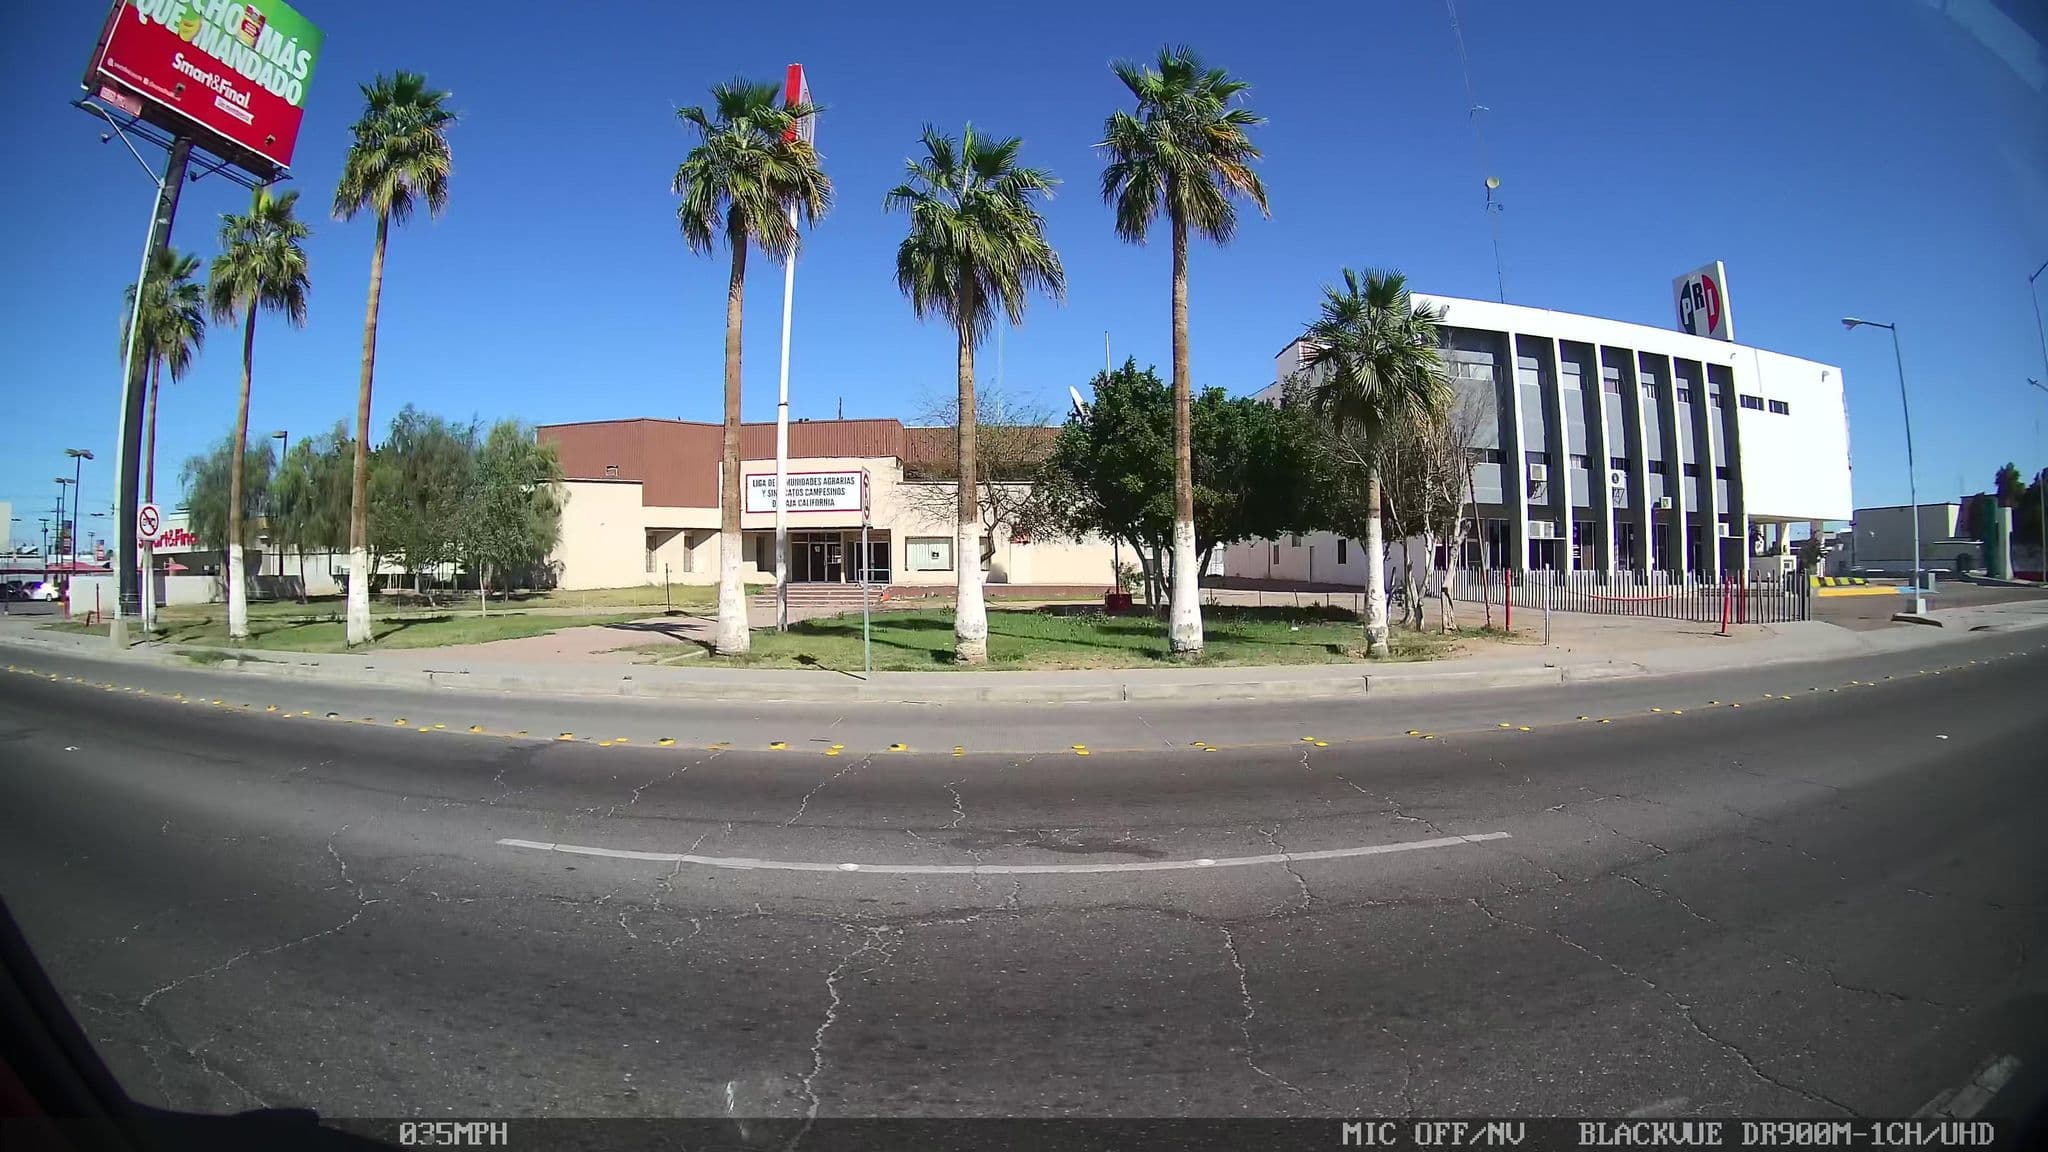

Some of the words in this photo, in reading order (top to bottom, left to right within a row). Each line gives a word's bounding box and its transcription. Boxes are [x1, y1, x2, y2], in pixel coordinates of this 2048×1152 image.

[191, 20, 303, 106] MANDADO
[255, 23, 312, 81] MÁS
[172, 52, 251, 109] Smart&Final
[1681, 282, 1716, 325] PRI
[797, 497, 835, 507] CALIFORNIA
[805, 487, 846, 497] CAMPESINOS
[823, 476, 855, 486] AGRARIAS
